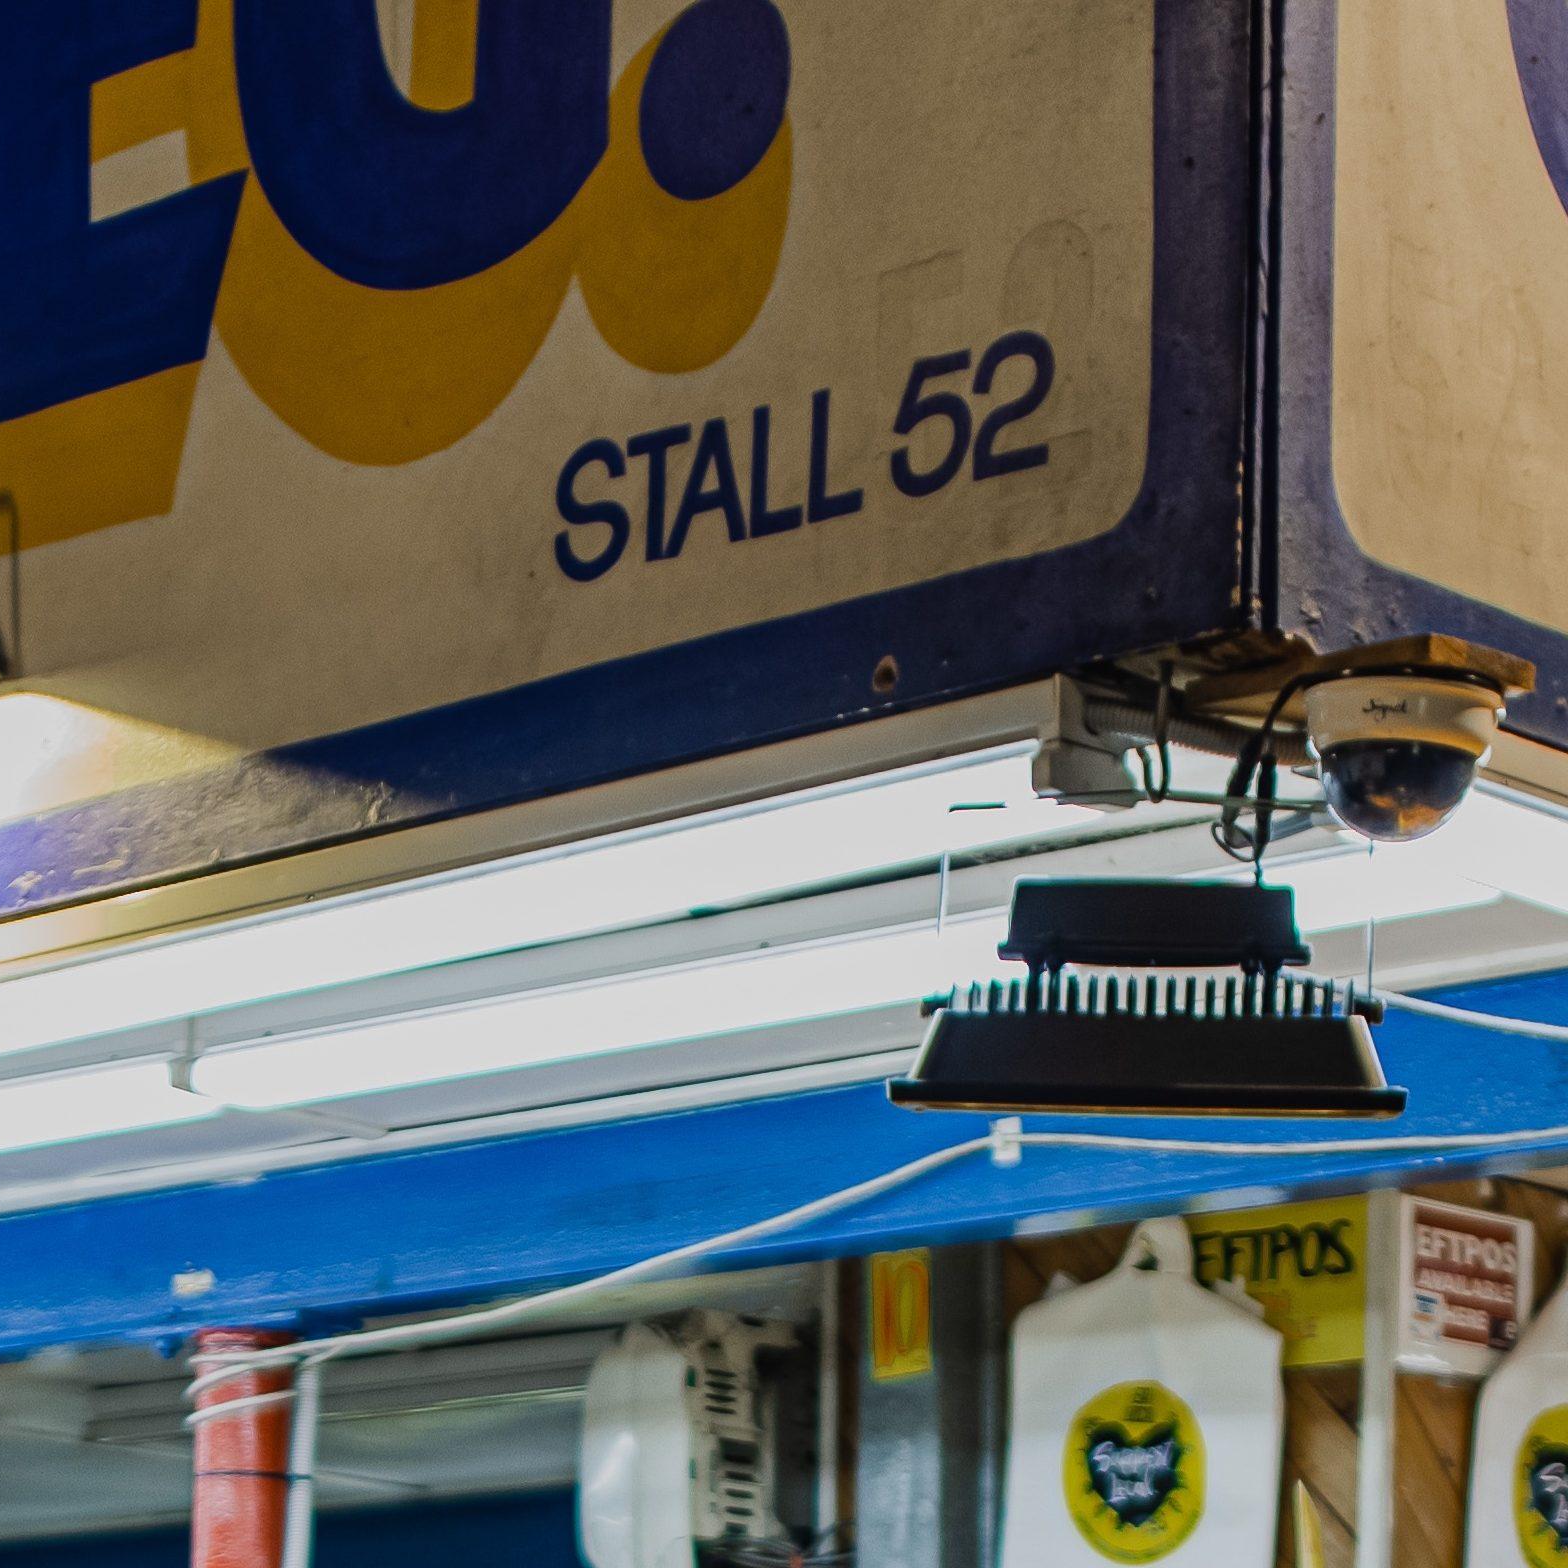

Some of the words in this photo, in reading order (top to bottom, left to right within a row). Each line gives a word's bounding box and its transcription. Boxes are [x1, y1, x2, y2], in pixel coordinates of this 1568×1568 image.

[554, 390, 862, 582] STALL
[889, 329, 1056, 498] 52
[1192, 1216, 1355, 1286] EFTPOS
[1414, 1221, 1517, 1276] EFTPOS
